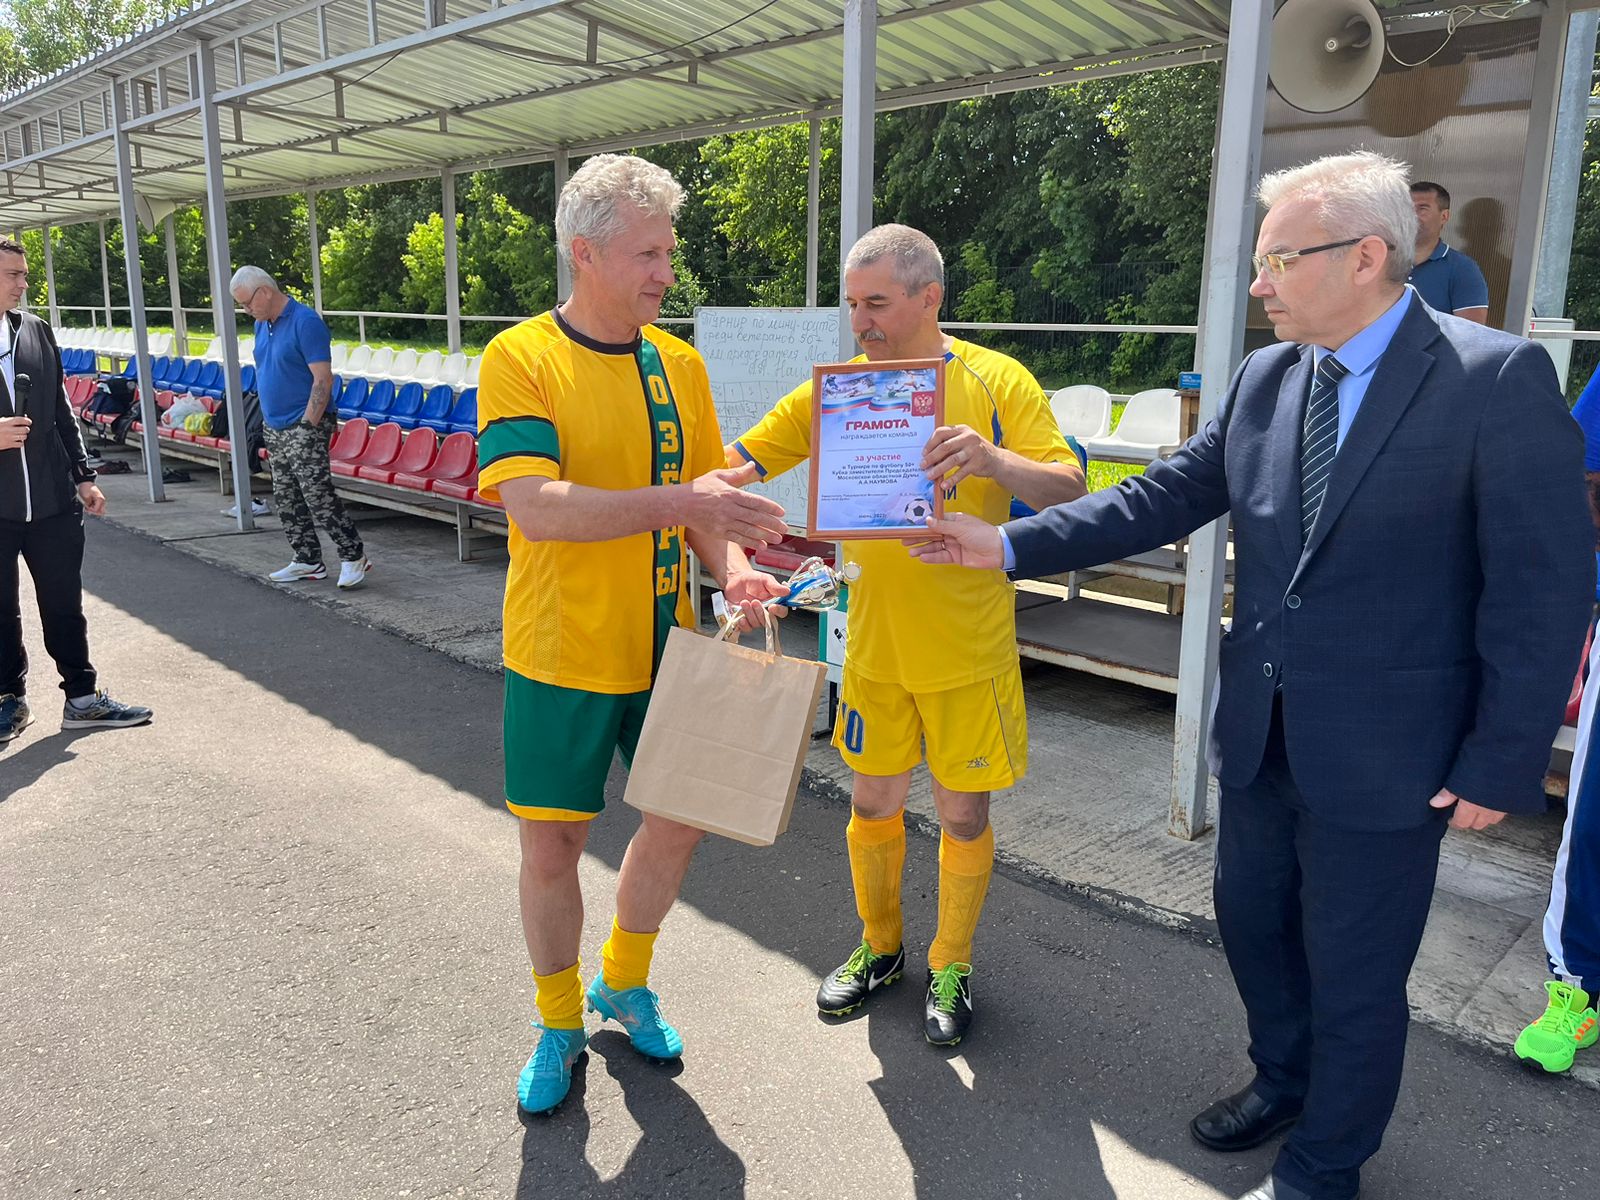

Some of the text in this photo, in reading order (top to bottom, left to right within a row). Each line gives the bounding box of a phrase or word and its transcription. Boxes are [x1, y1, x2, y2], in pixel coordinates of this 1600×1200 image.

[846, 418, 910, 431] ГРАМОТА
[840, 431, 918, 441] награждается команда
[866, 453, 902, 463] участие
